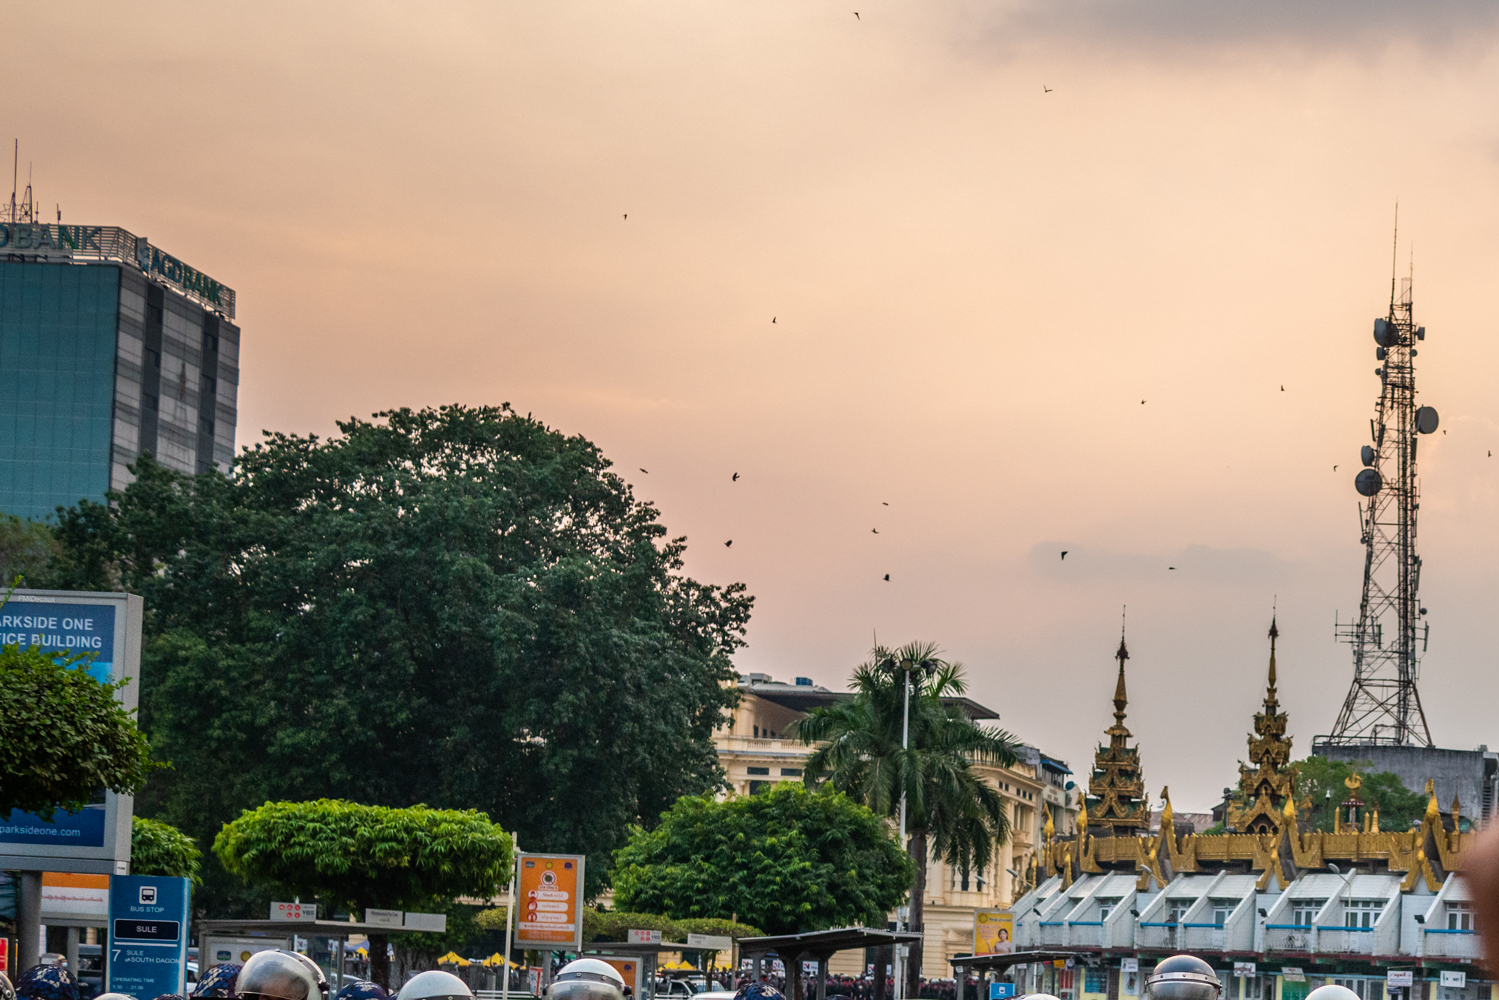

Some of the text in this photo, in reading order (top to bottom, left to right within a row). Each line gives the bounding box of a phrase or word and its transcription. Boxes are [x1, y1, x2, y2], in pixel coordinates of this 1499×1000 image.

[0, 615, 93, 631] RKSIDE ONE
[31, 633, 102, 649] BUILDING
[136, 925, 157, 933] SULE
[112, 949, 121, 961] 7
